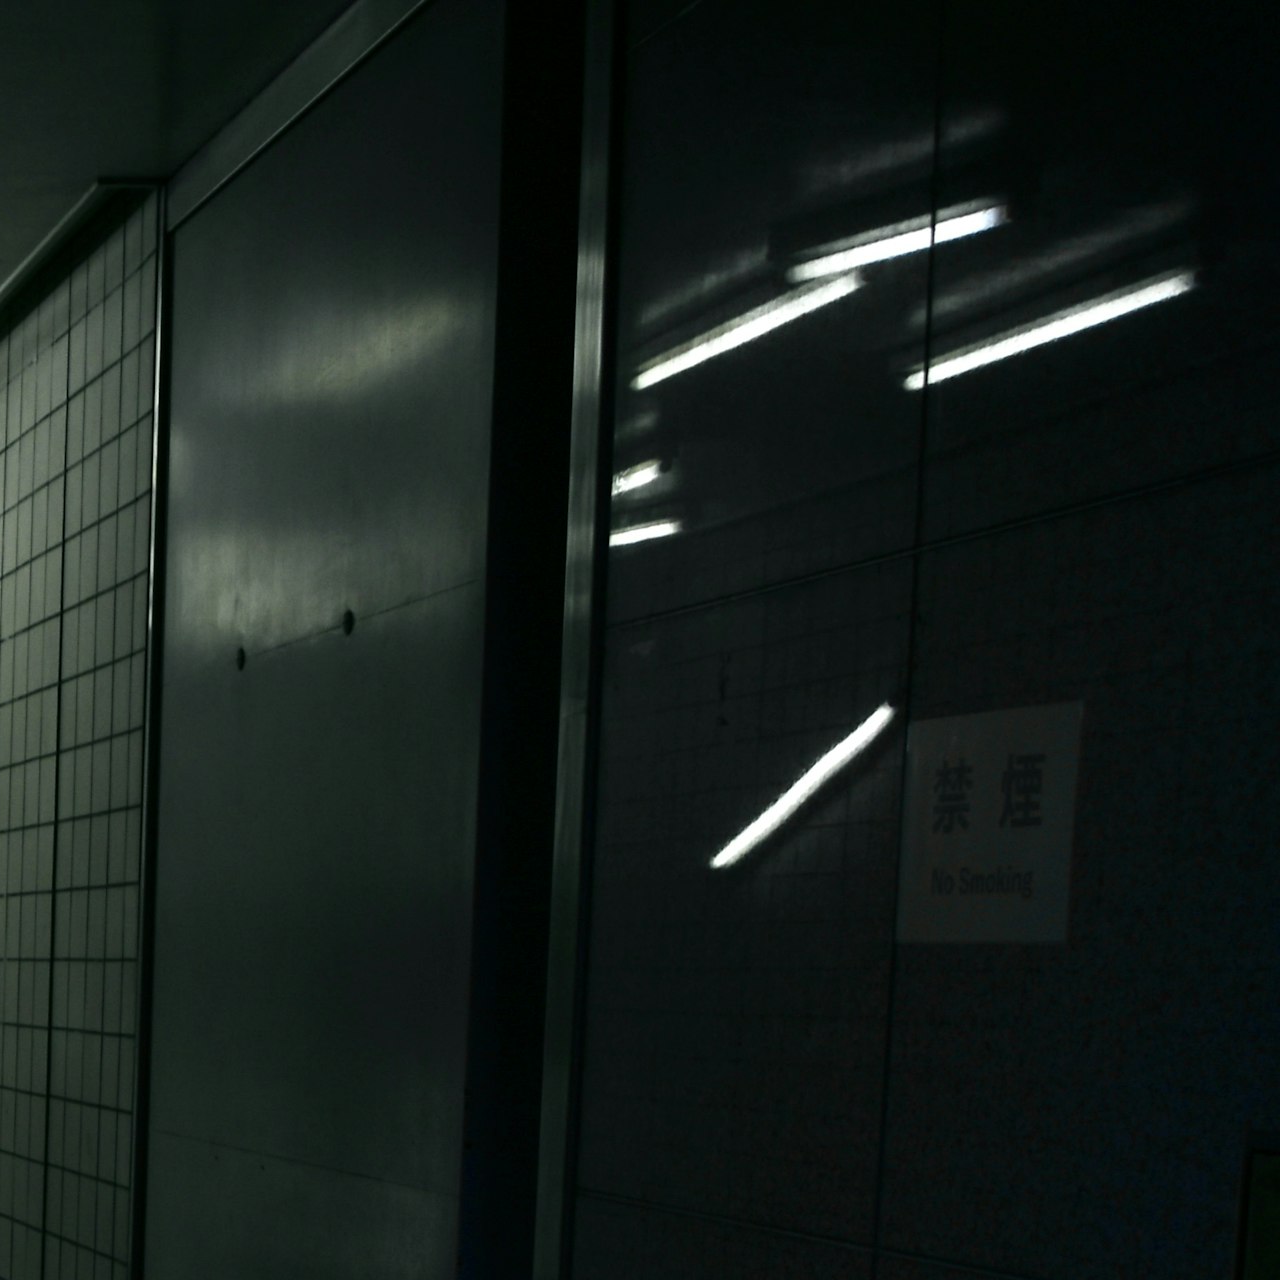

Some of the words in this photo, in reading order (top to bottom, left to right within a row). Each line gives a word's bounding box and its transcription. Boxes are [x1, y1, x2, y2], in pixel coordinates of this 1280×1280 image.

[931, 753, 1046, 834] 禁煙
[931, 867, 955, 895] No
[958, 865, 1034, 898] Smoking
